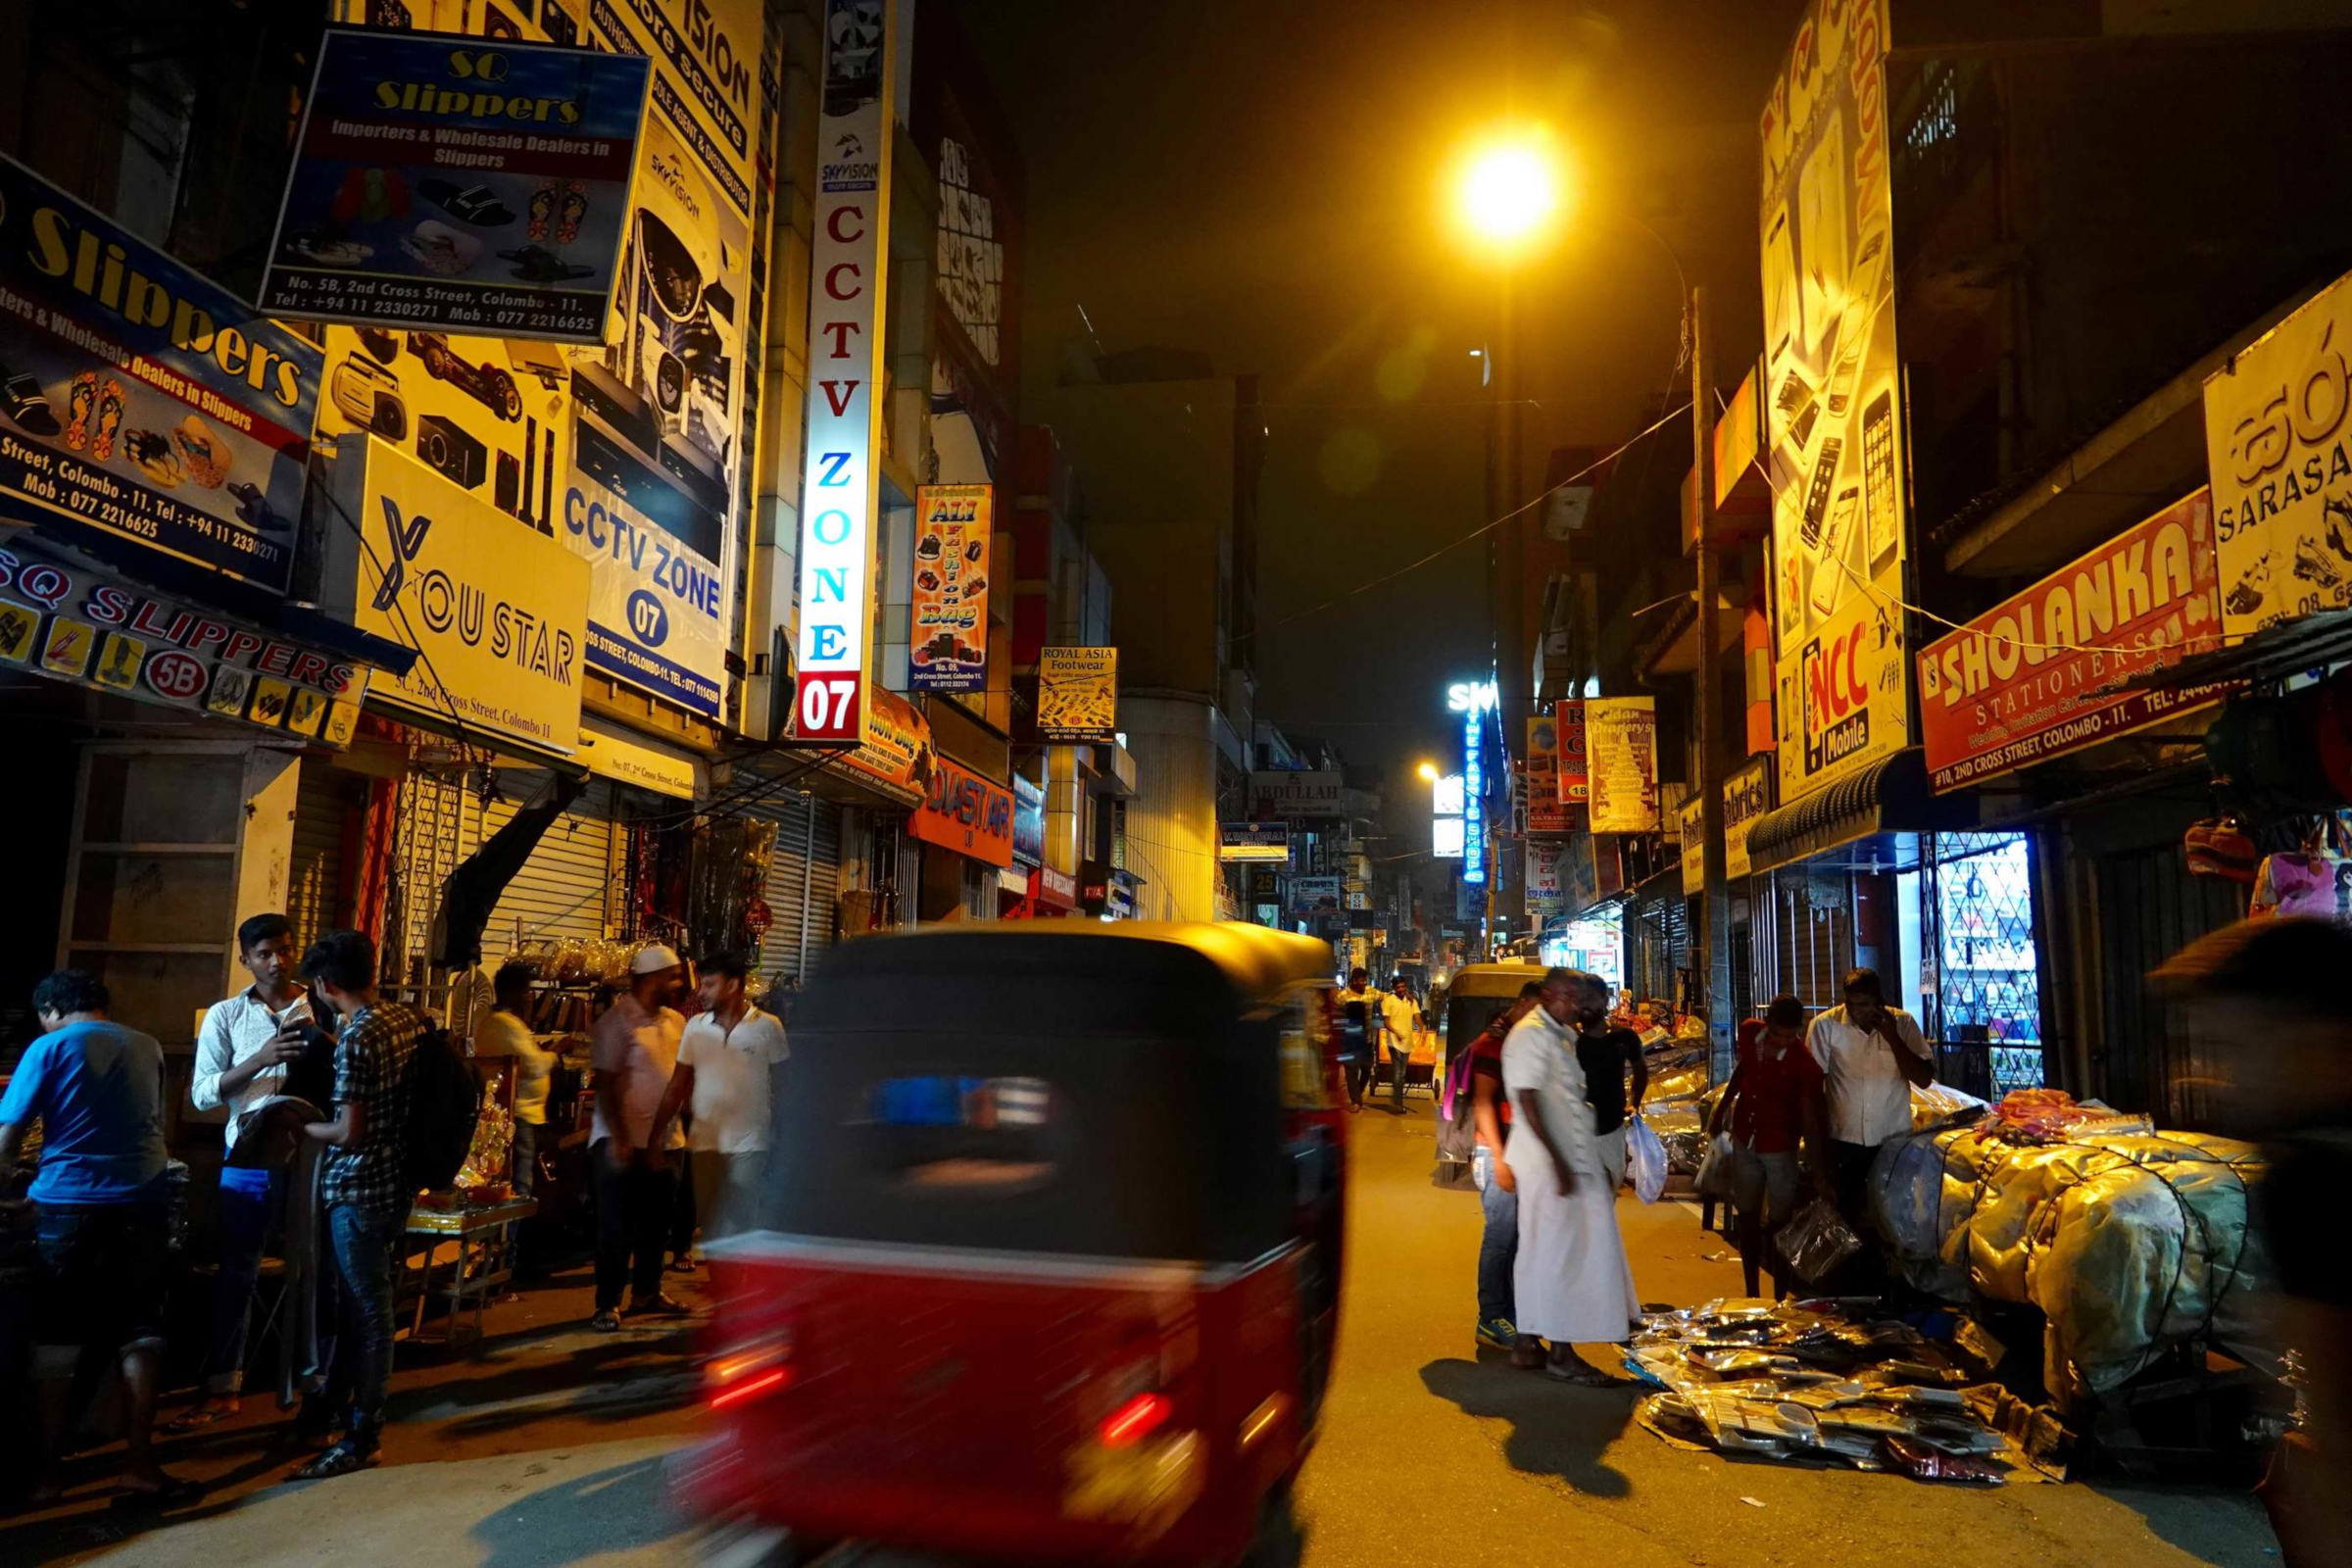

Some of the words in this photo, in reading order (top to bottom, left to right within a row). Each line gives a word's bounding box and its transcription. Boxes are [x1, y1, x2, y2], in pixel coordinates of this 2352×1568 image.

[448, 51, 510, 82] SQ
[632, 0, 675, 53] ore
[679, 54, 744, 148] secure
[682, 0, 750, 118] ISION
[373, 80, 580, 124] Slippers
[332, 119, 416, 142] Importers
[418, 128, 430, 142] &
[435, 128, 522, 150] Wholesale
[525, 135, 589, 156] Dealers
[592, 141, 611, 158] in
[434, 148, 505, 169] Slippers
[671, 102, 698, 140] AGENT
[705, 141, 749, 208] DISTRIBUTOR
[651, 154, 700, 220] SKYVISION
[821, 163, 878, 182] SKYVISION
[27, 207, 302, 407] Slippers
[288, 275, 314, 291] No.
[318, 277, 343, 294] 5B,
[346, 279, 375, 296] 2nd
[380, 282, 420, 300] Cross
[424, 286, 476, 305] Street,
[481, 292, 544, 310] Colombo
[562, 298, 583, 313] 11.
[313, 297, 344, 311] +94
[351, 298, 368, 312] 11
[374, 301, 439, 318] 2330271
[497, 310, 524, 325] 077
[529, 313, 595, 330] 2216625
[819, 206, 865, 417] CCTV
[35, 306, 47, 326] &
[49, 311, 129, 369] Wholesale
[131, 356, 185, 397] Dealers
[186, 385, 200, 405] in
[201, 393, 253, 431] Slippers
[1, 436, 54, 474] Street,
[59, 456, 120, 499] Colombo
[132, 489, 151, 513] 11.
[186, 515, 213, 537] +94
[217, 523, 228, 544] 11
[232, 530, 279, 562] 2330271
[70, 490, 98, 514] 077
[101, 502, 158, 539] 2216625
[929, 501, 978, 523] ALI
[2218, 440, 2352, 542] SARASA
[564, 486, 647, 571] CCTV
[653, 542, 720, 619] ZONE
[808, 453, 853, 662] ZONE
[634, 598, 661, 639] 07
[918, 605, 977, 629] Bag
[1944, 520, 2193, 707] SHOLANKA
[87, 586, 354, 694] SLIPPERS
[600, 637, 628, 664] STREET,
[1043, 649, 1081, 659] ROYAL
[1084, 649, 1113, 659] ASIA
[1052, 661, 1105, 670] Footwear
[156, 658, 197, 694] 5B
[1810, 621, 1868, 734] NCC
[1976, 631, 2146, 726] STATIONERS
[416, 681, 437, 701] 2nd
[440, 687, 468, 712] Cross
[470, 699, 500, 722] Street,
[502, 709, 540, 735] Colombo
[802, 680, 856, 731] 07
[1828, 717, 1866, 762] Mobile
[1935, 771, 1954, 788] #10,
[1954, 764, 1974, 781] 2ND
[1975, 752, 2004, 772] CROSS
[2004, 737, 2043, 764] STREET,
[2044, 714, 2101, 750] COLOMBO
[2113, 705, 2132, 725] 11.
[2143, 690, 2175, 713] TEL:
[1251, 784, 1339, 800] ABDULLAH
